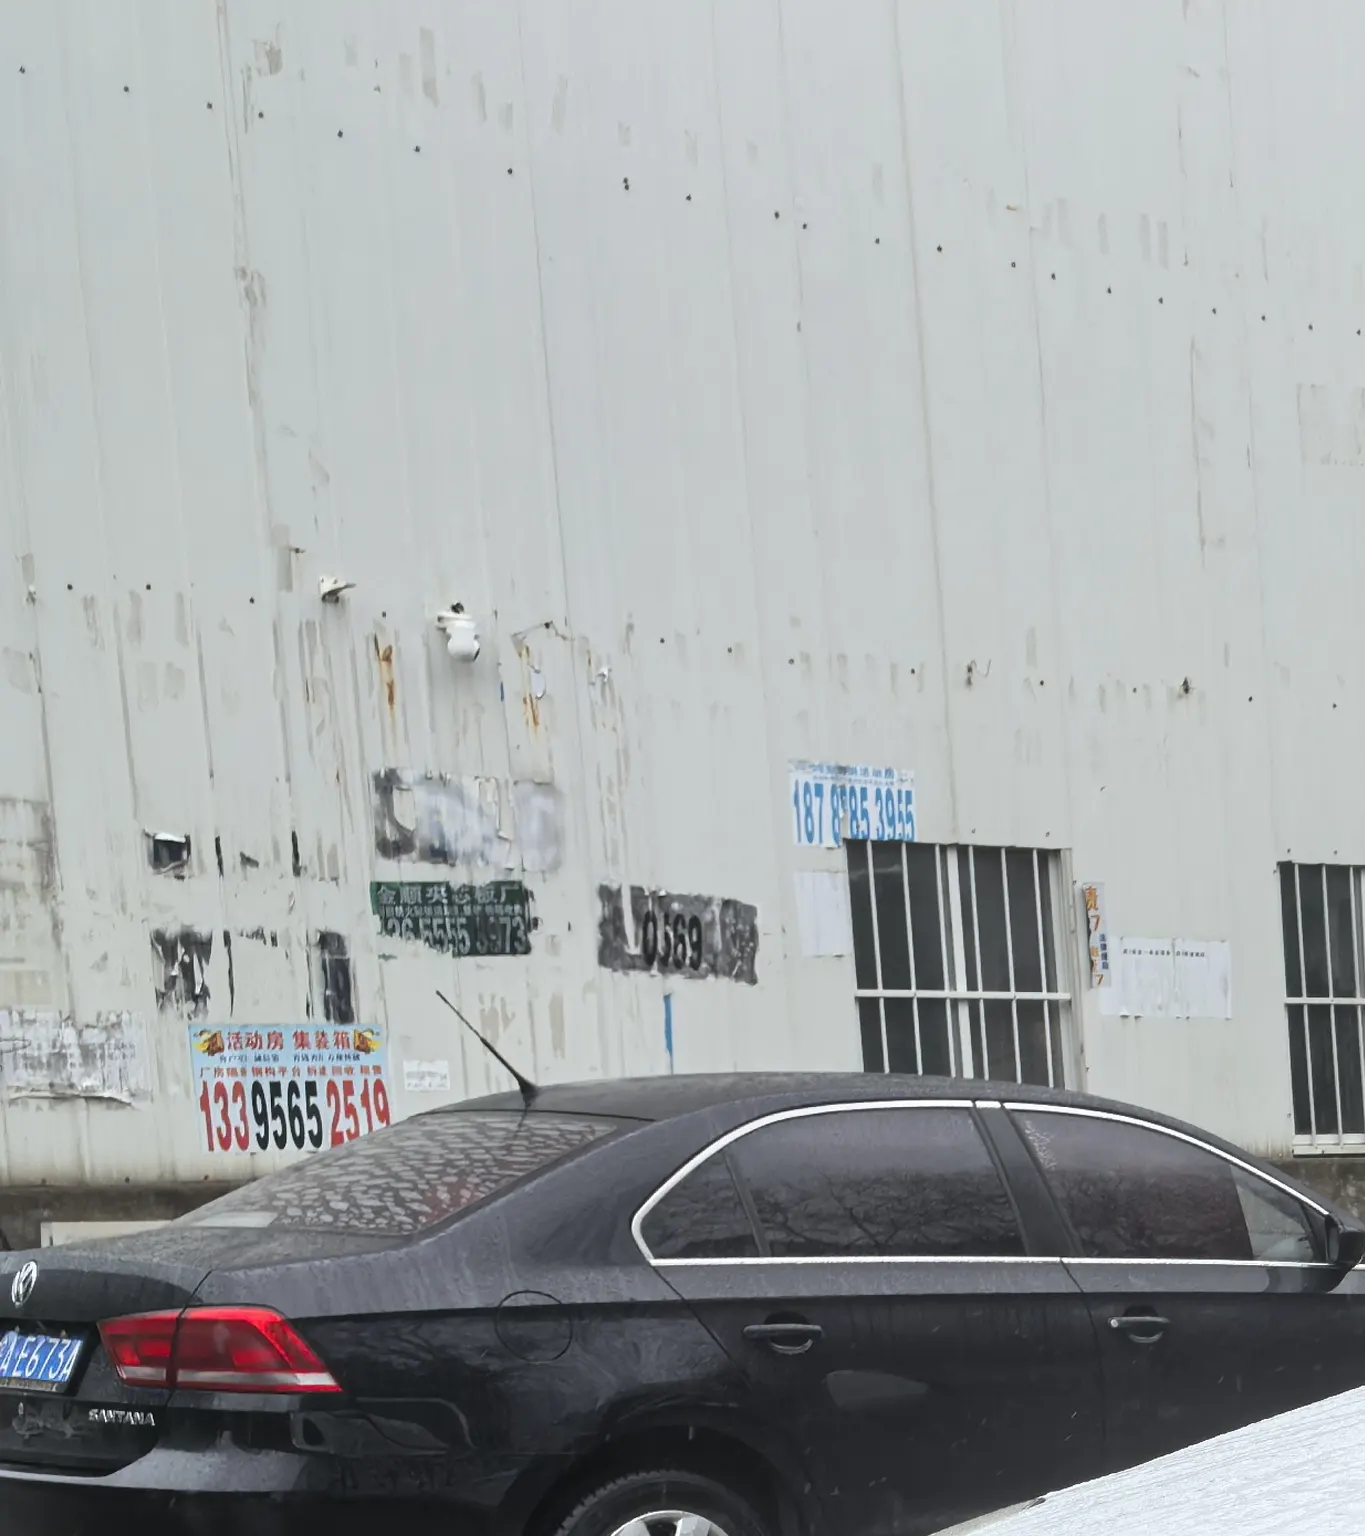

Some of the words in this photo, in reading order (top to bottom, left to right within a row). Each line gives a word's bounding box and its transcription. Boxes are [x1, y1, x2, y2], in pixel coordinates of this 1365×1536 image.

[793, 780, 824, 843] 187
[227, 1031, 285, 1051] 活动房
[293, 1030, 352, 1051] 集装箱
[200, 1080, 250, 1152] 133
[251, 1079, 324, 1150] 9565
[326, 1078, 391, 1149] 2519
[0, 1330, 83, 1382] AE673A
[88, 1407, 156, 1427] SANTANA
